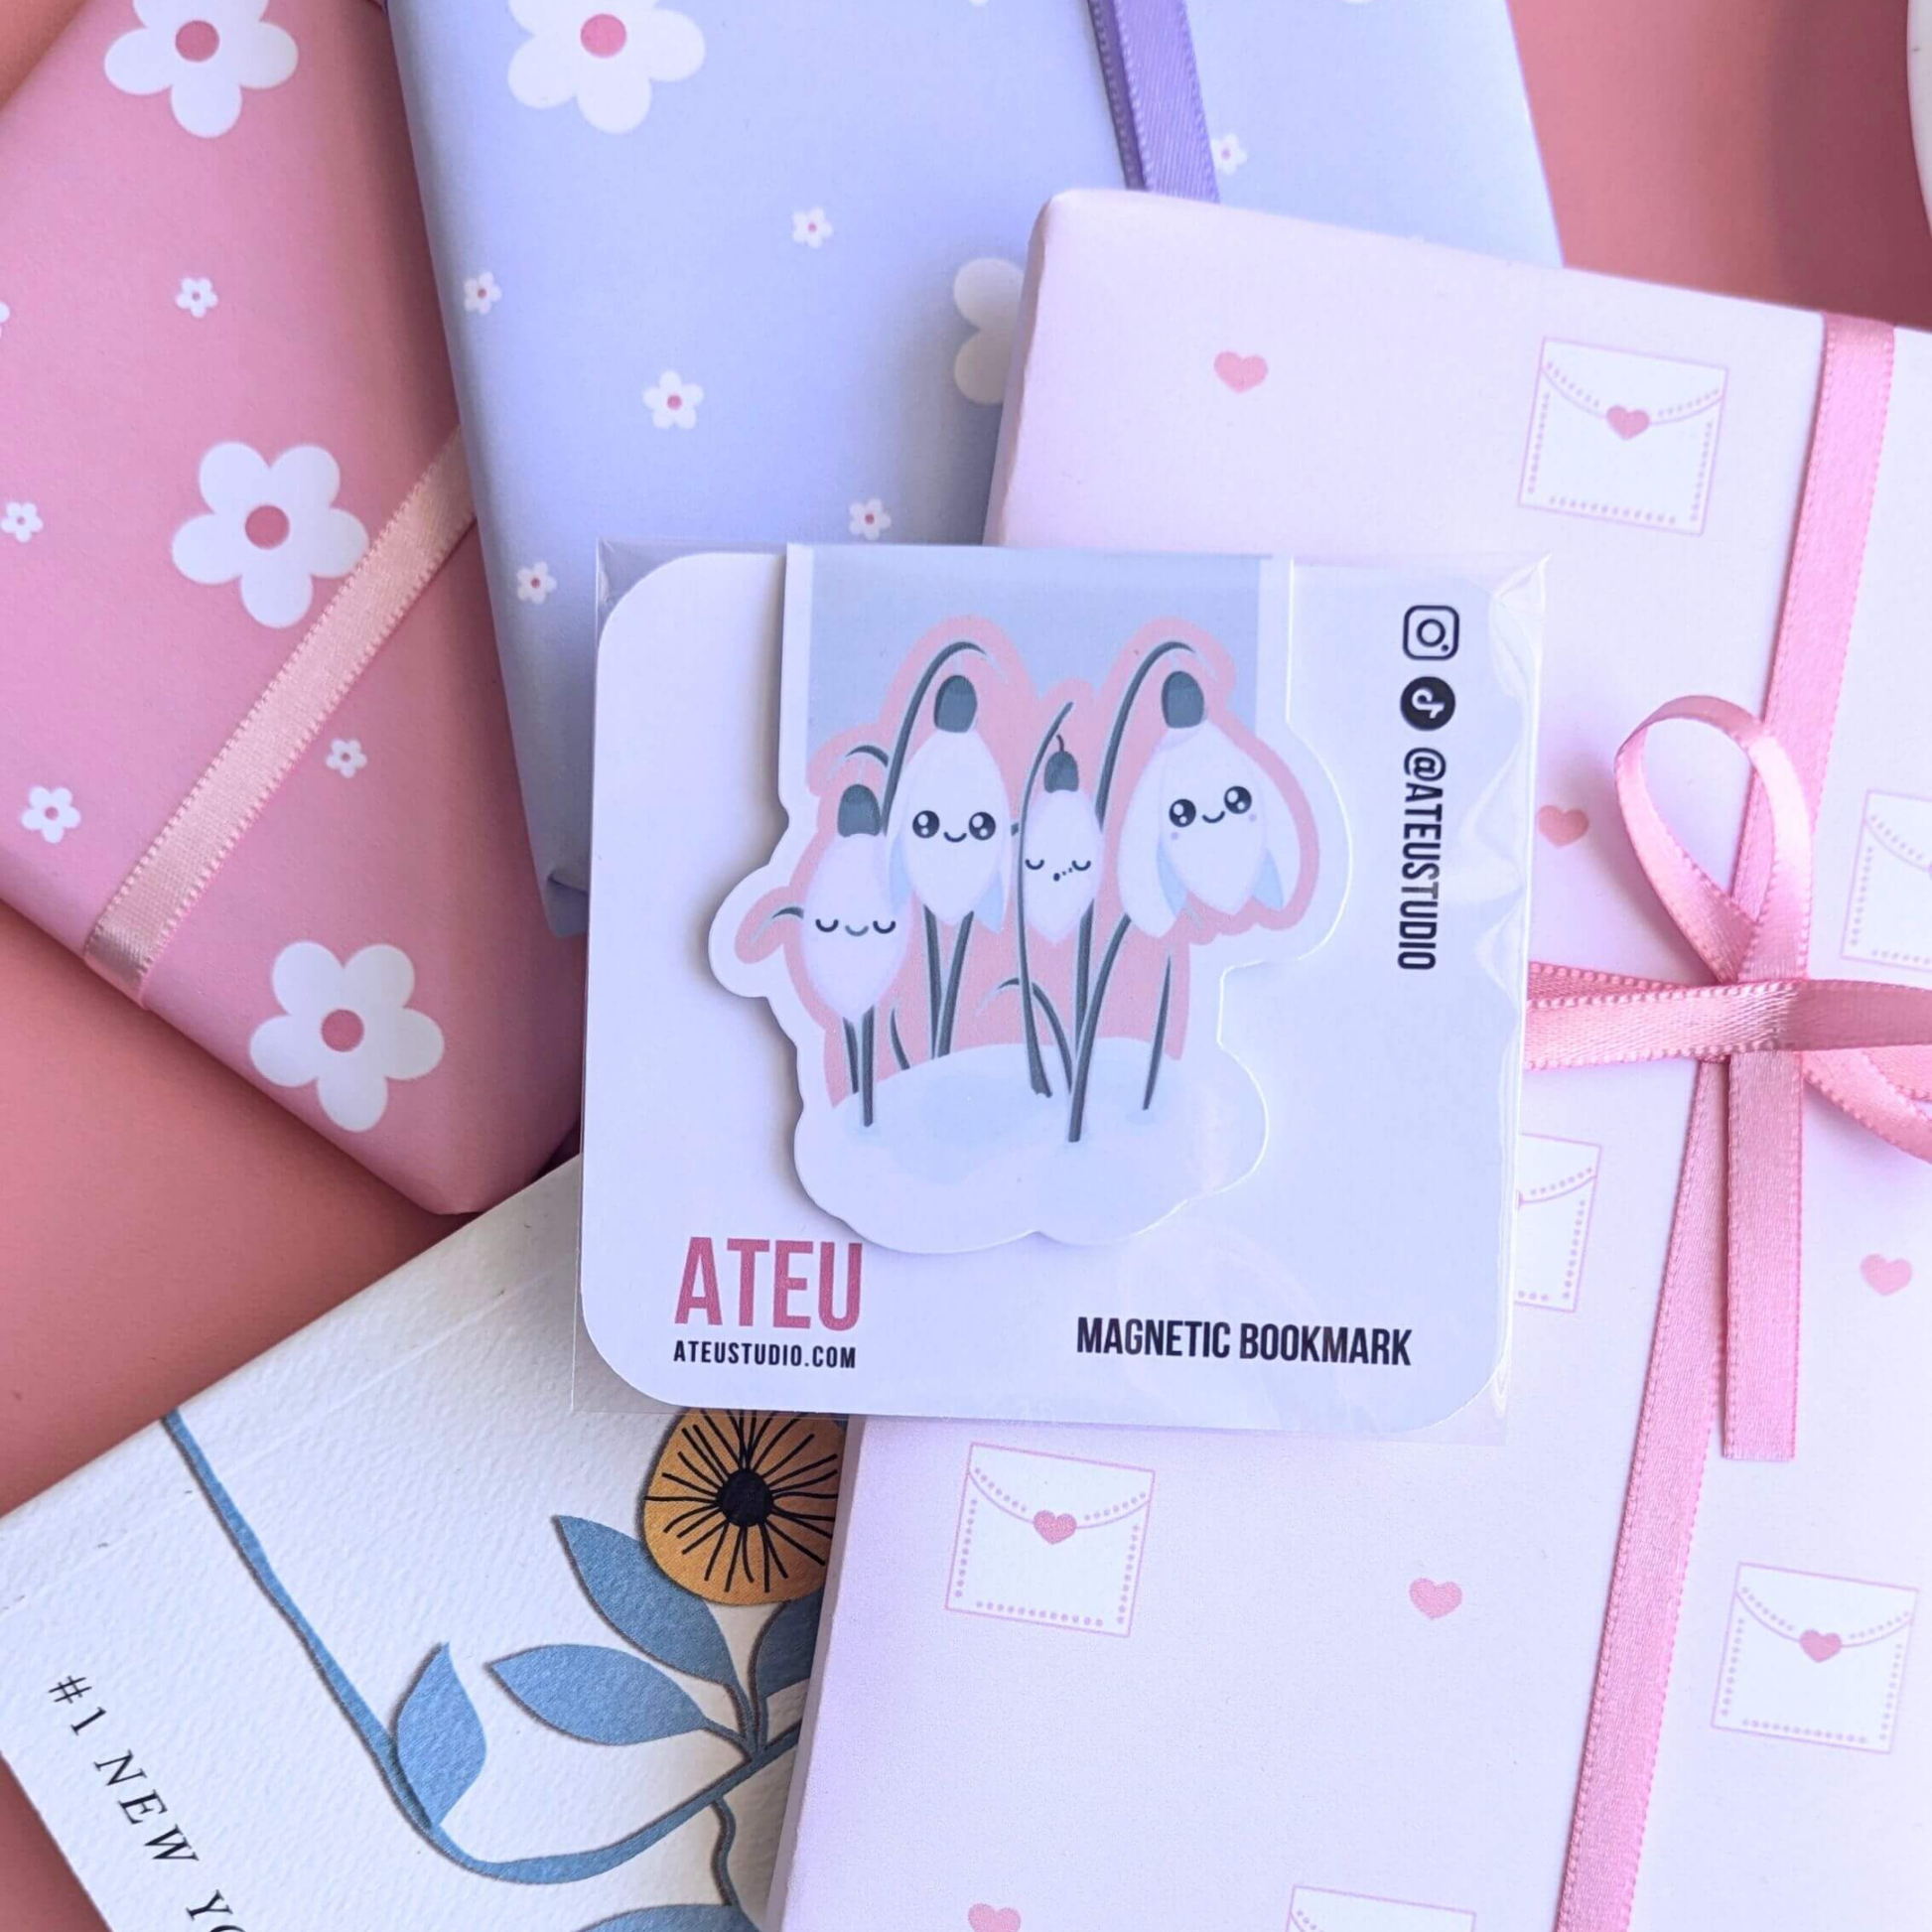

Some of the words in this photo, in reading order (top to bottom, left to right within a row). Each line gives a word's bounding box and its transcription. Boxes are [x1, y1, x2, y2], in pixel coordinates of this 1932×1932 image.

[1397, 747, 1447, 970] @ATEUSTUDIO
[674, 1236, 863, 1331] ATEU
[673, 1339, 857, 1369] ATEUSTUDIO.COM
[1076, 1316, 1231, 1359] MAGNETIC
[1239, 1322, 1413, 1366] BOOKMARK
[48, 1675, 107, 1736] #1
[93, 1748, 200, 1862] NEW
[186, 1889, 246, 1932] Y
